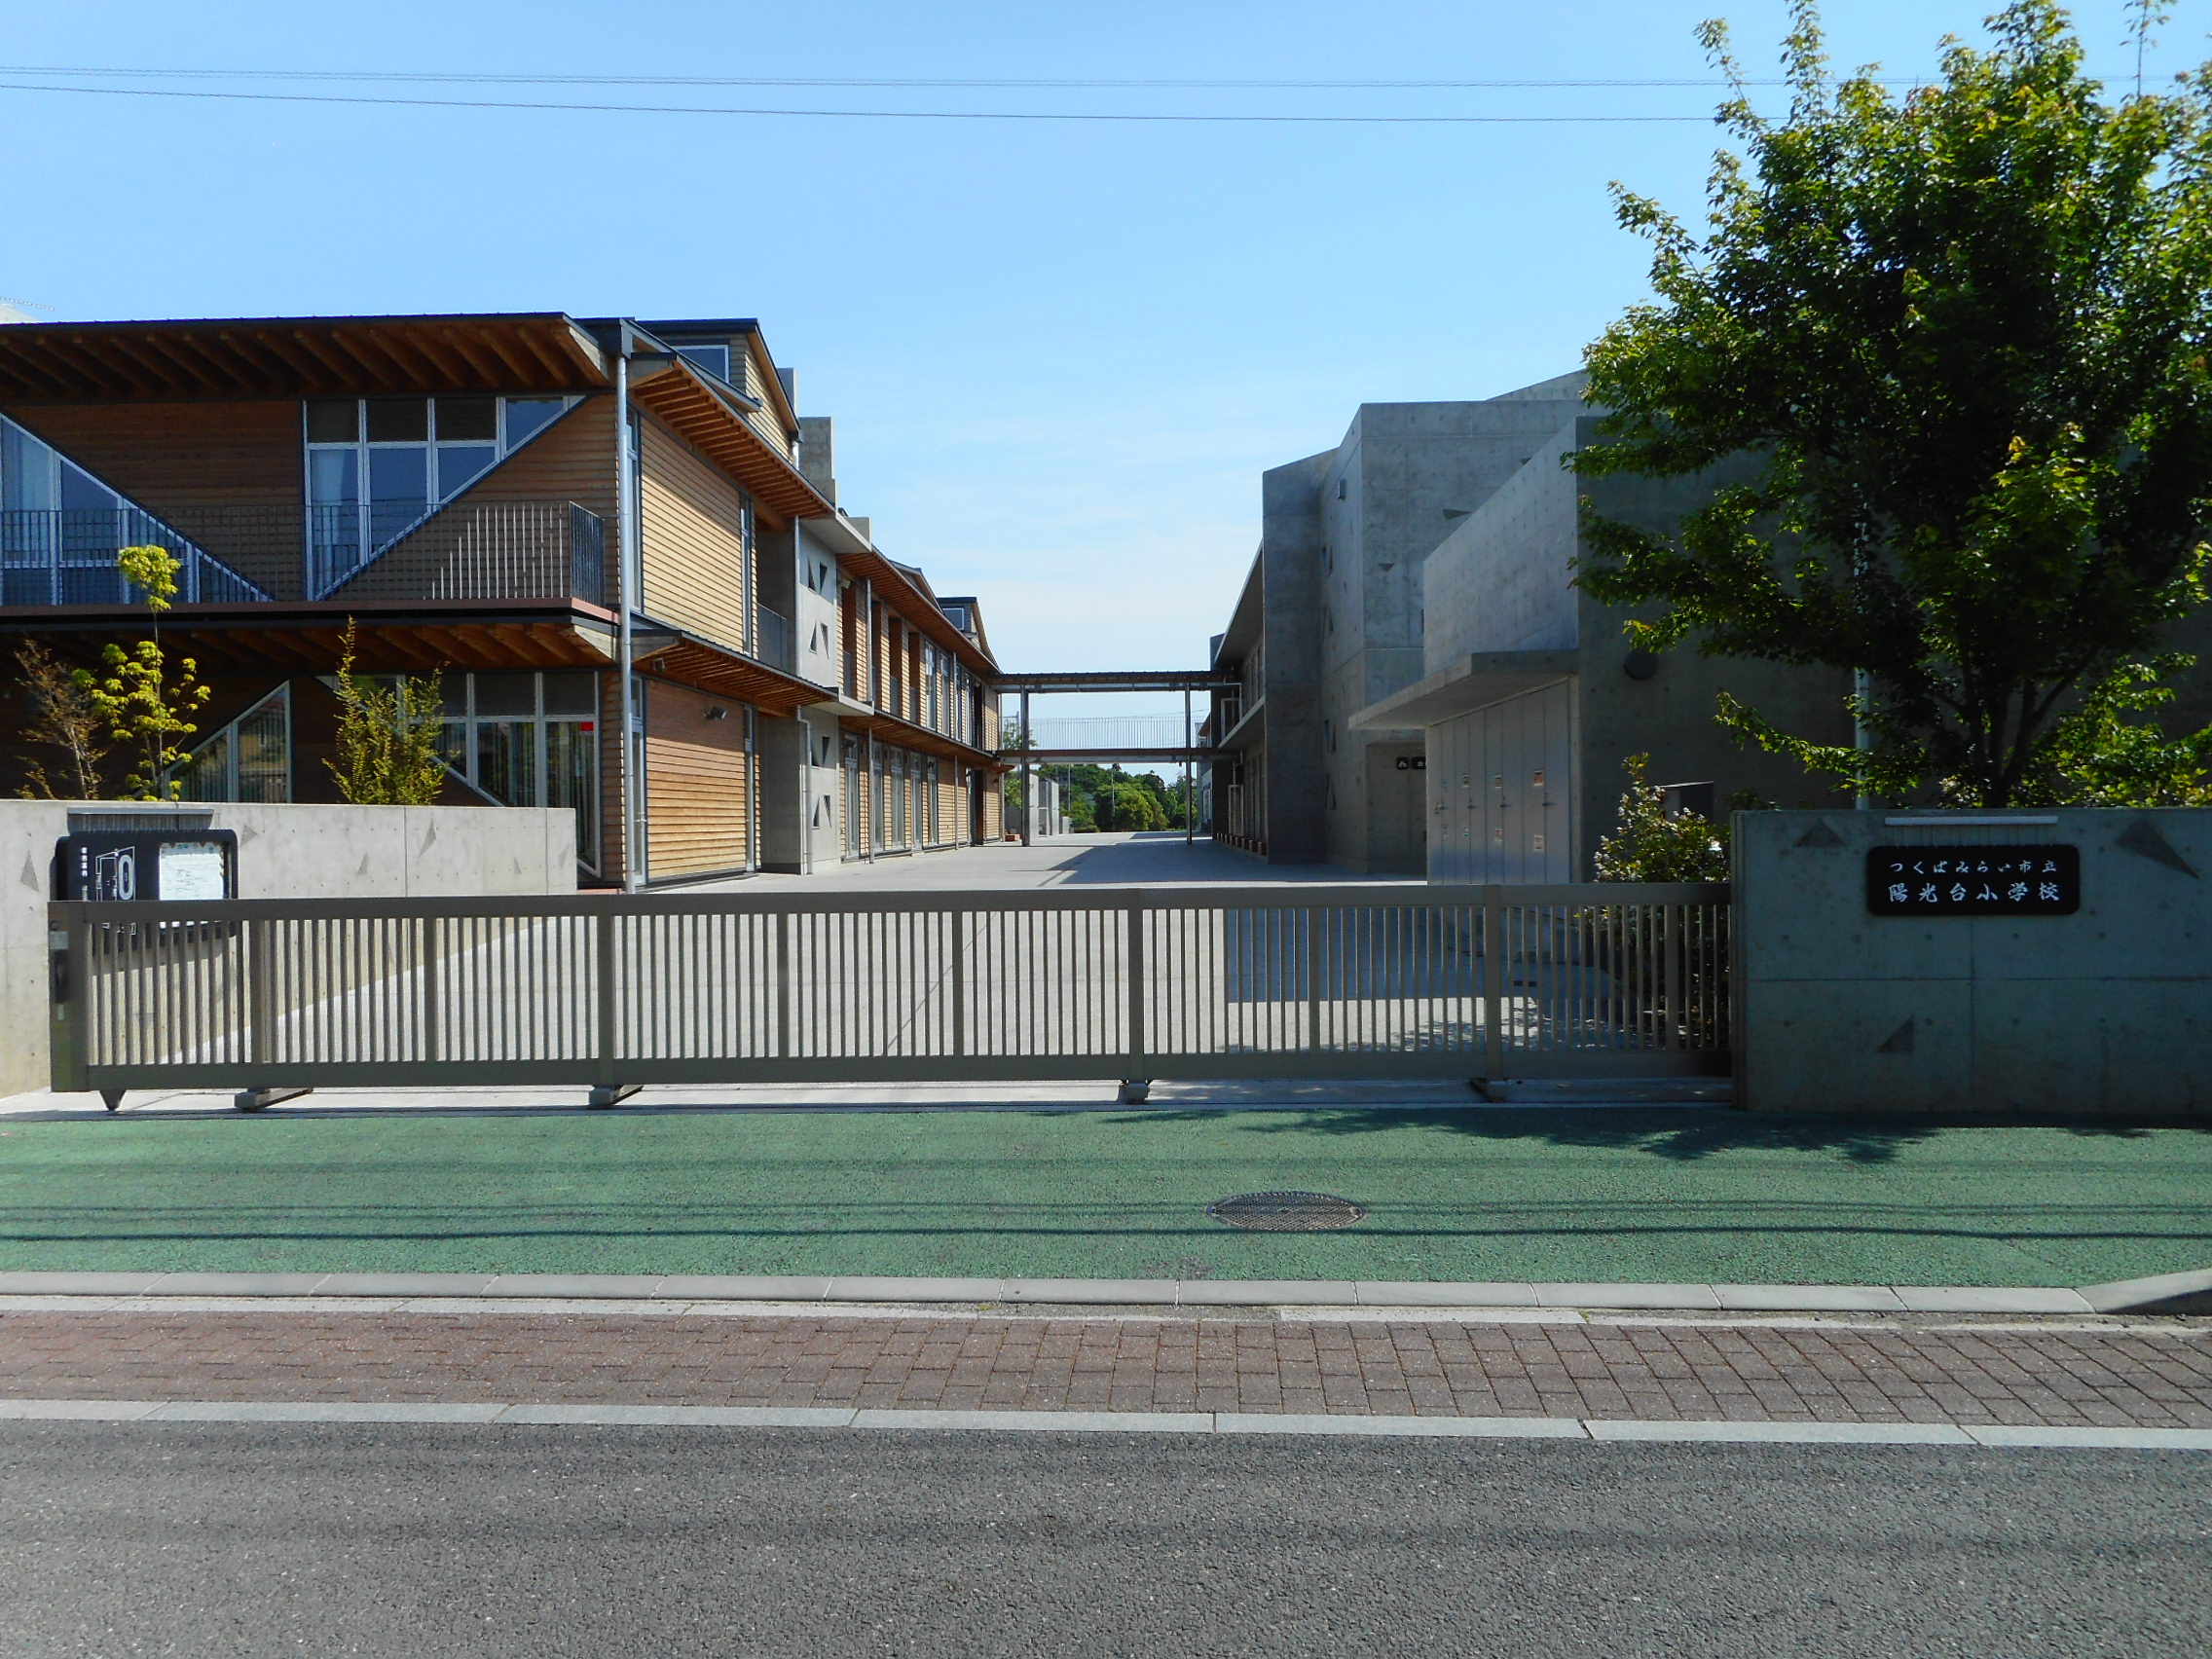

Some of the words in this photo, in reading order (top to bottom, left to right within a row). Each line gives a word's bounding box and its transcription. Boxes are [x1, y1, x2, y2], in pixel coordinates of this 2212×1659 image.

[1889, 860, 2057, 874] つくばみらい市立
[1888, 882, 2062, 903] 陽光台小学校
